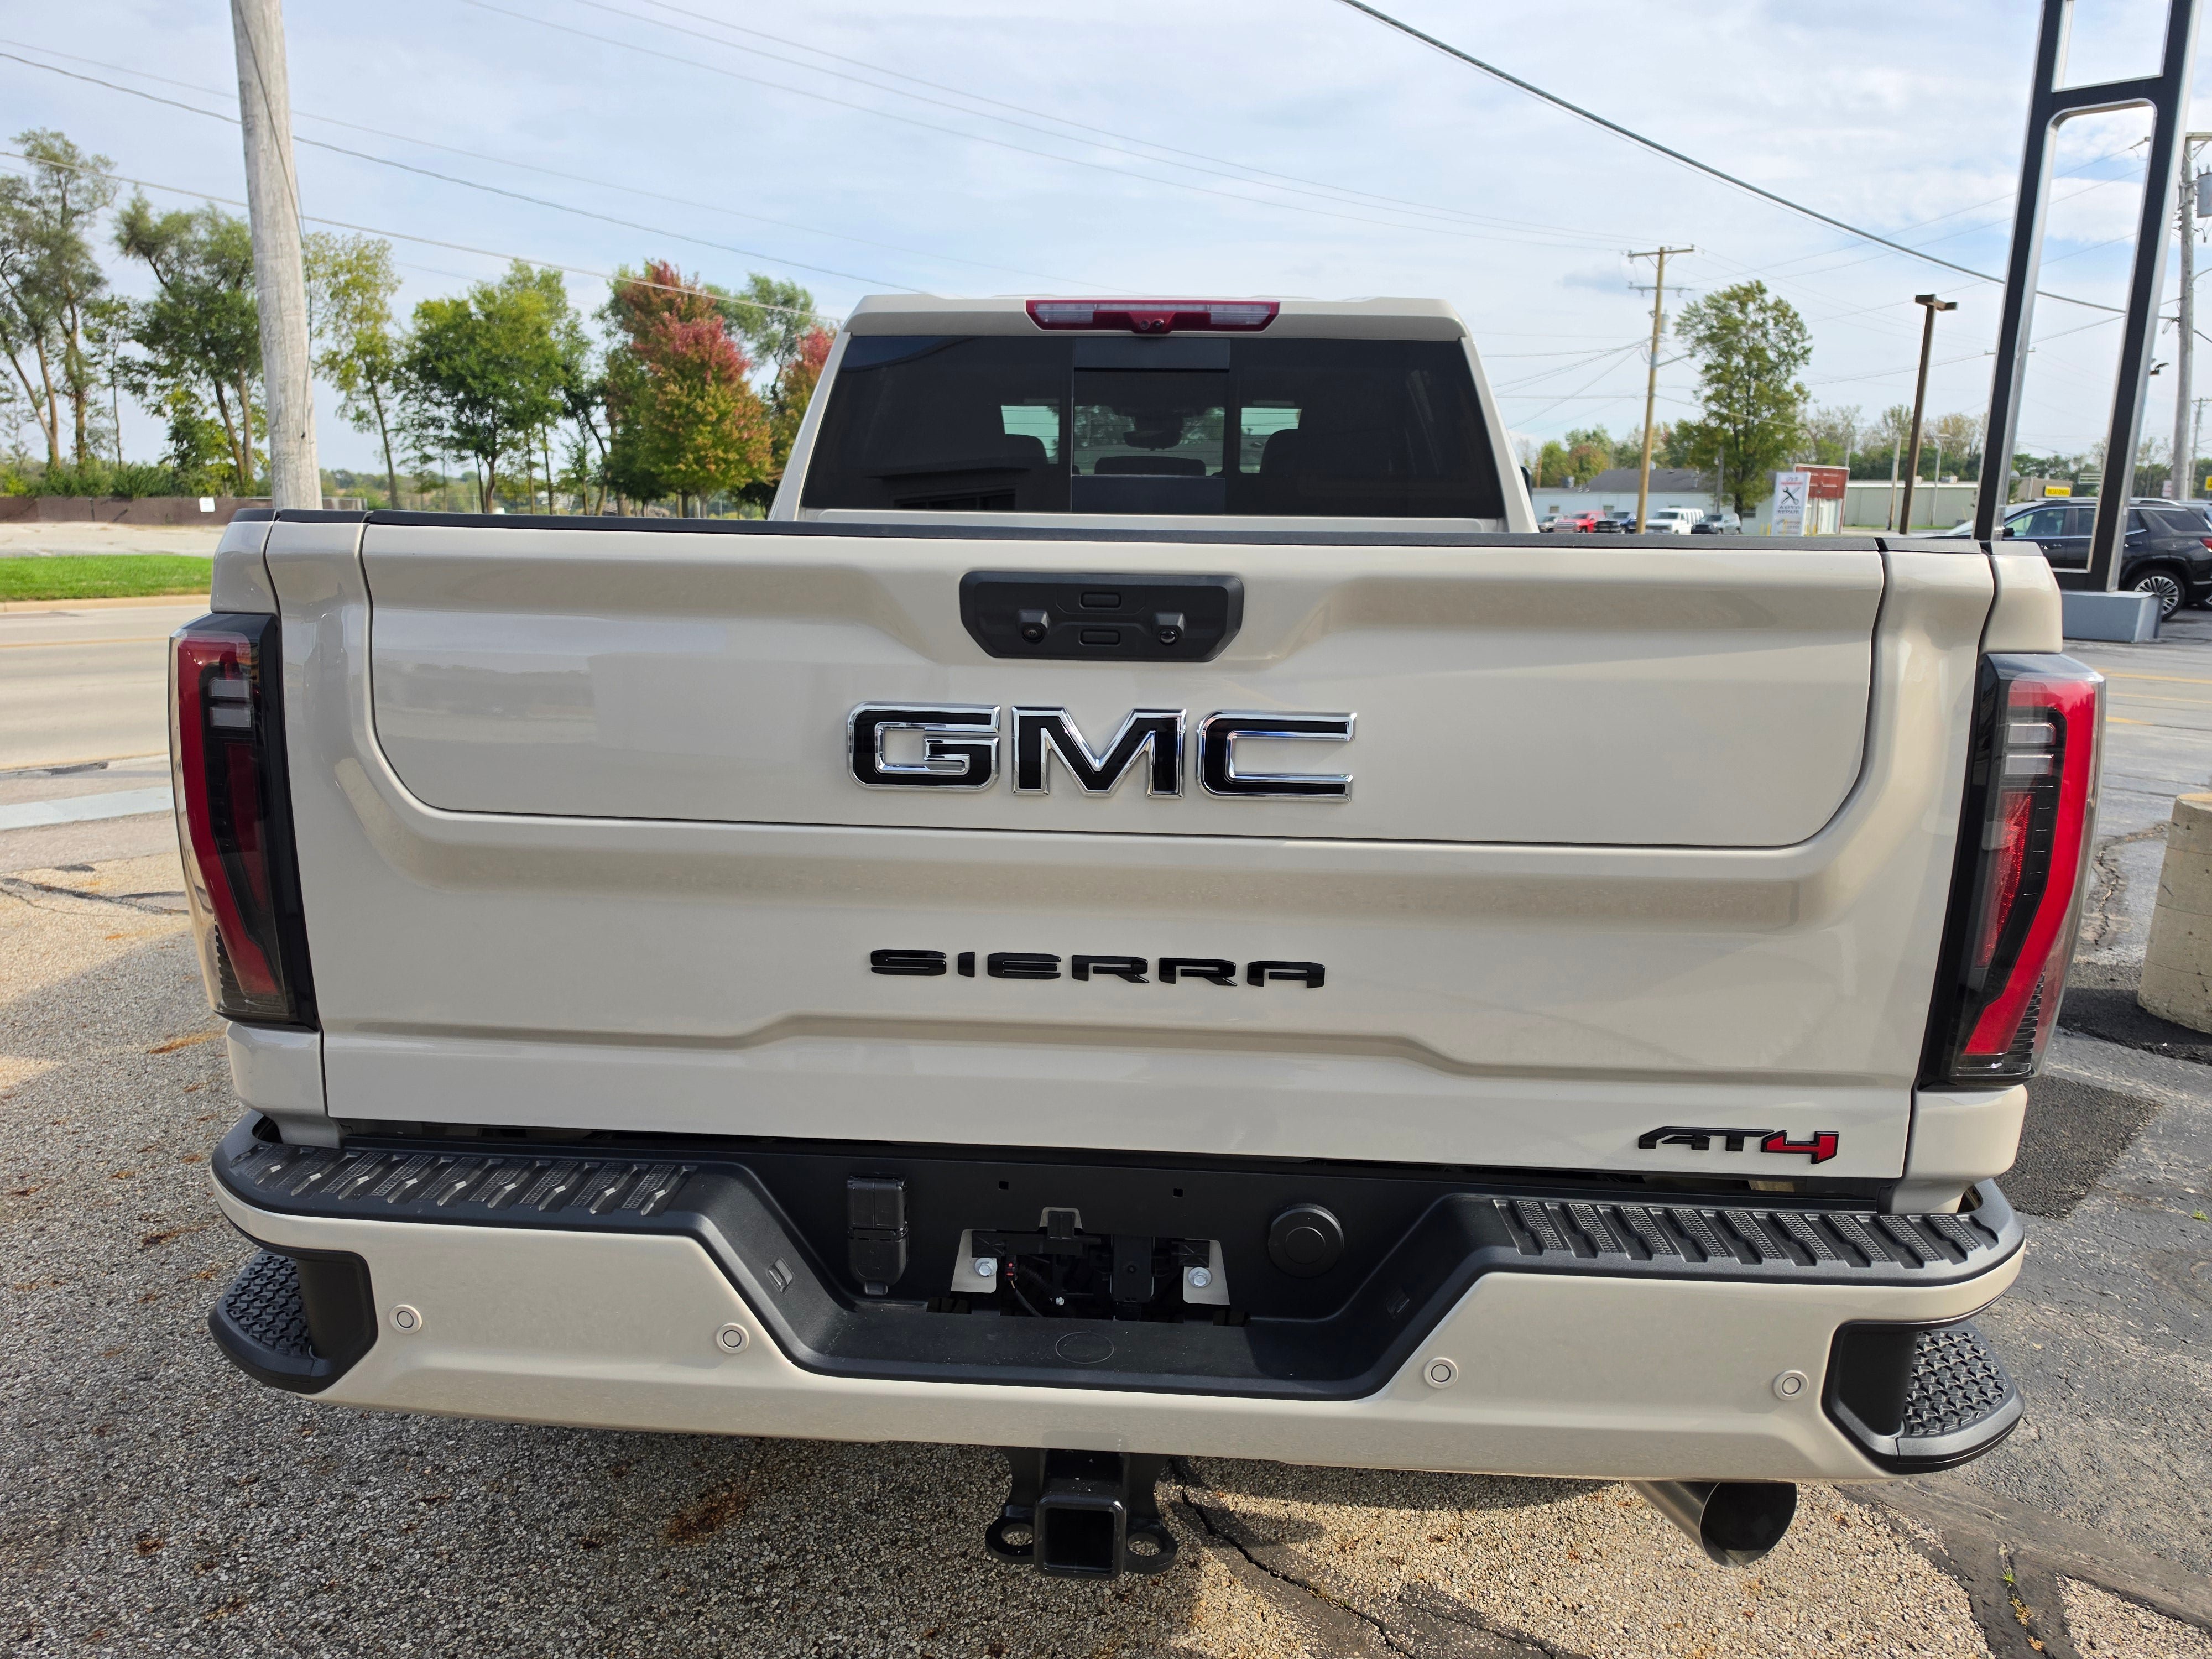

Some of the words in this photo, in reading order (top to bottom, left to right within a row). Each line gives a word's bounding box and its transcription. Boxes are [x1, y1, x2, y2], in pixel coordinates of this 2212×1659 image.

[848, 701, 1357, 802] GMC
[870, 949, 1326, 989] SIERRA
[1639, 1126, 1839, 1164] AT4
